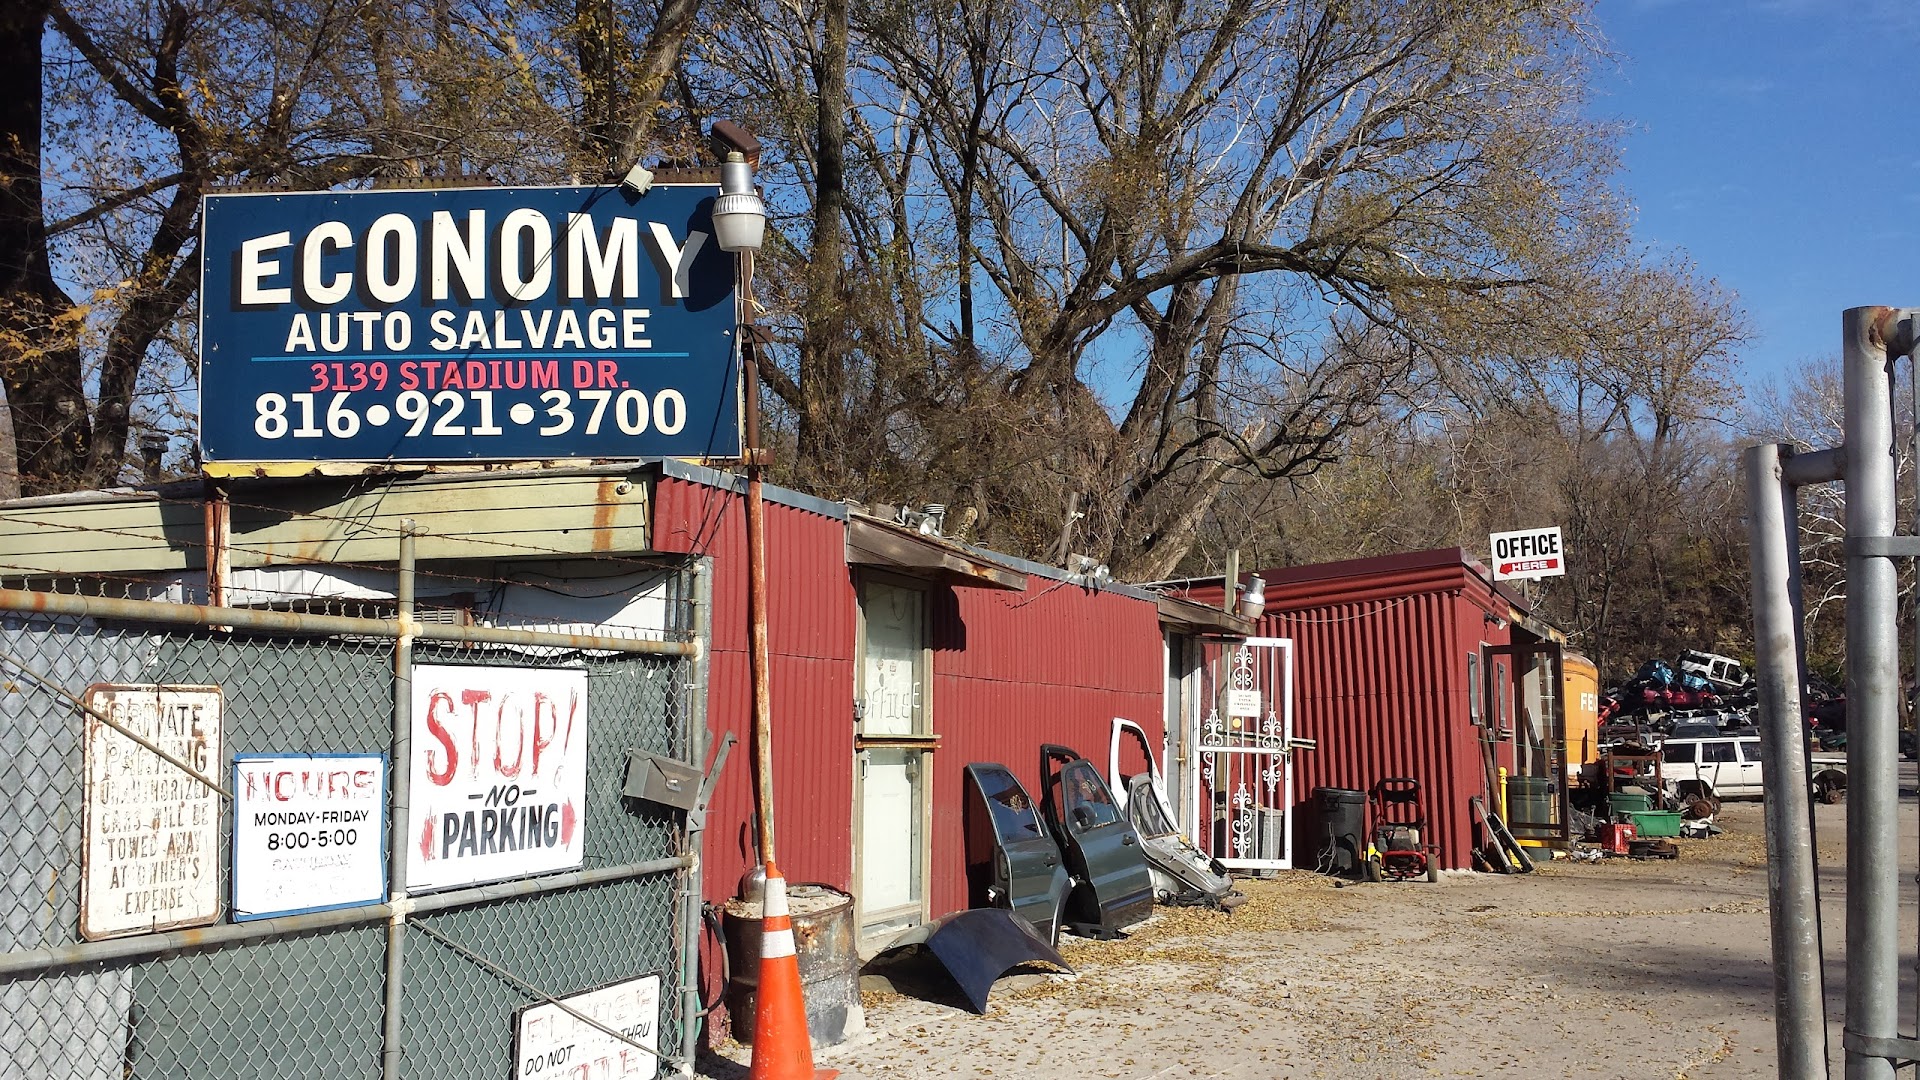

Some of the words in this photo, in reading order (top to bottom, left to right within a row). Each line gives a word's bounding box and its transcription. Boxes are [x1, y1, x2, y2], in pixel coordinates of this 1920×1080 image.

[240, 207, 708, 305] ECONOMY
[284, 311, 412, 353] AUTO
[430, 308, 653, 351] SALVAGE
[310, 361, 389, 393] 3139
[399, 360, 560, 391] STADIUM
[572, 360, 629, 390] DR.
[1496, 533, 1559, 559] OFFICE
[1511, 560, 1549, 572] HERE
[107, 702, 204, 738] PRIVATE
[424, 687, 577, 789] STOP!
[246, 770, 375, 801] HOURS
[485, 784, 520, 808] NO
[254, 810, 370, 827] MONDAY-FRIDAY
[442, 803, 559, 860] PARKING
[108, 834, 158, 861] TOWED
[166, 830, 202, 859] AWAY
[267, 829, 358, 851] 8:00-5:00
[109, 865, 127, 889] AT
[125, 886, 184, 915] EXPENSE
[525, 1054, 544, 1076] DO
[547, 1044, 576, 1069] NOT
[620, 1021, 652, 1044] THRU
